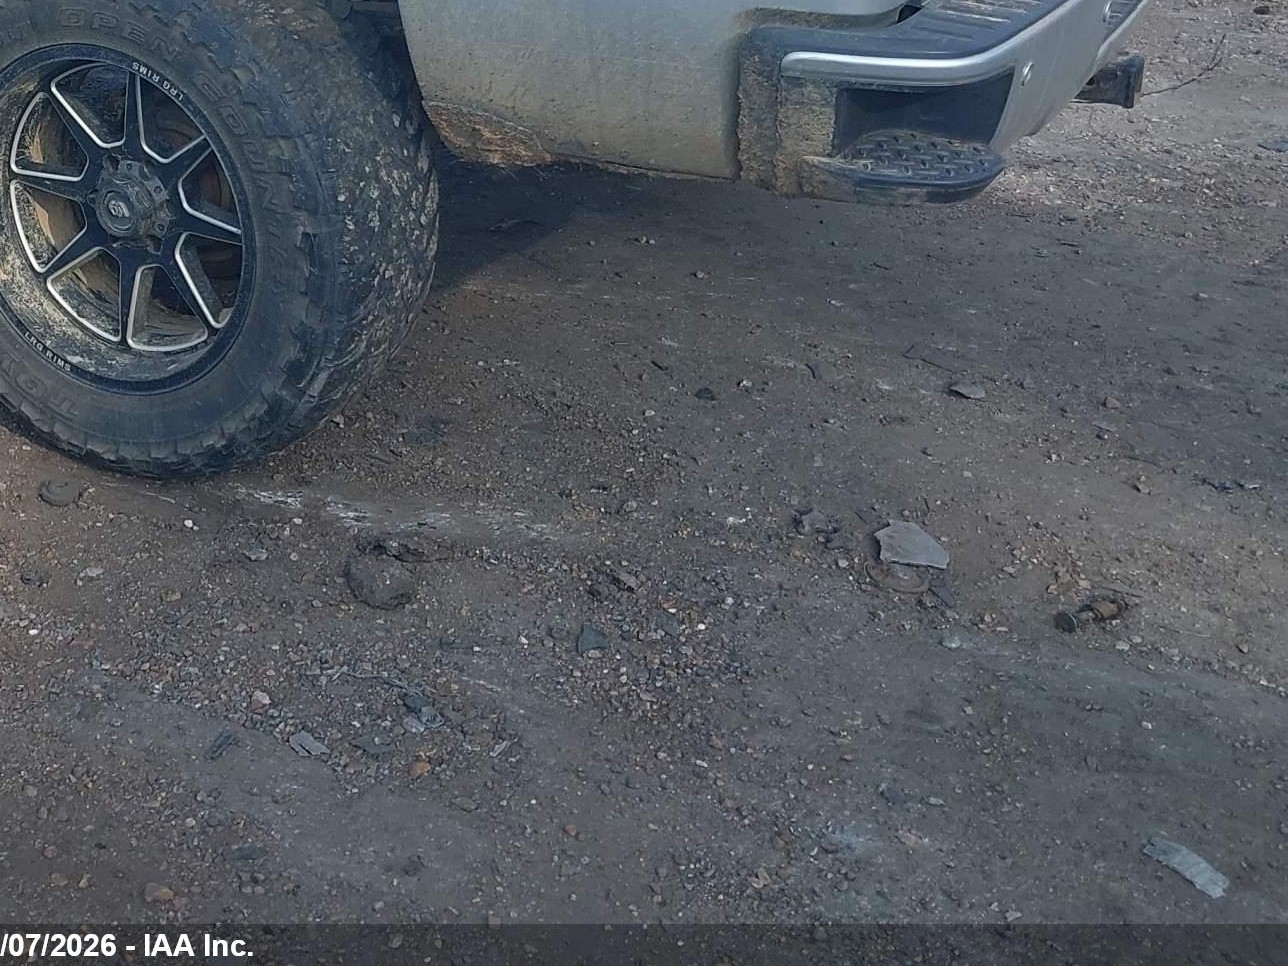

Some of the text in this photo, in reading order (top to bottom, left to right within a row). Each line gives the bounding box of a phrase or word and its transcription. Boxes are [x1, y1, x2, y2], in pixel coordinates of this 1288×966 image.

[132, 61, 184, 101] LRG RIMS
[24, 331, 71, 372] LRG RIMS
